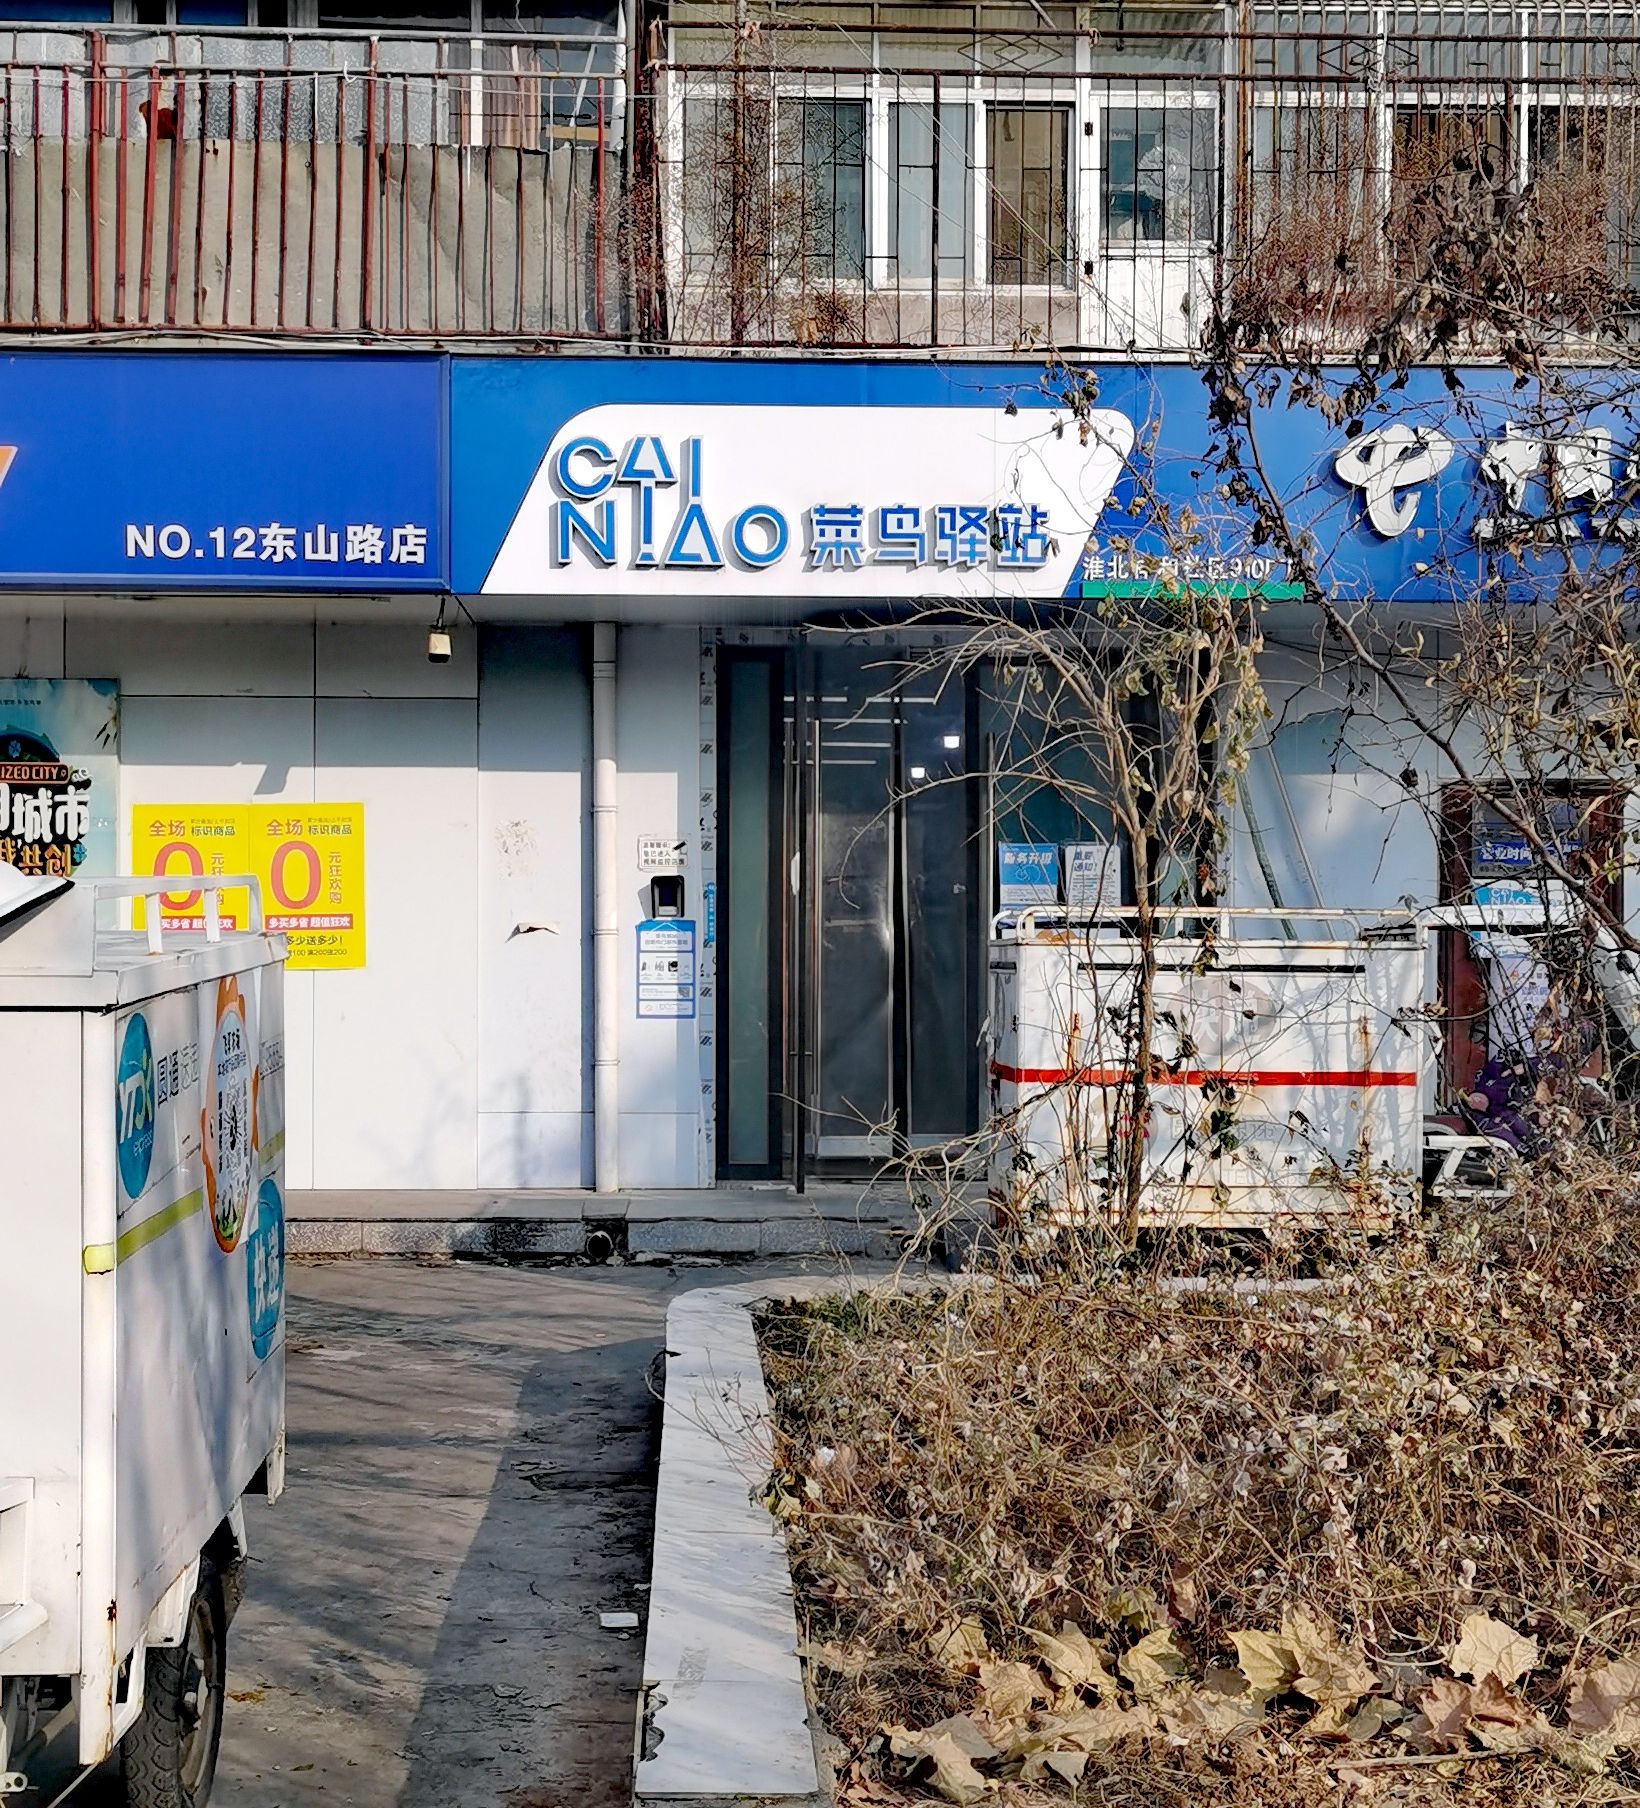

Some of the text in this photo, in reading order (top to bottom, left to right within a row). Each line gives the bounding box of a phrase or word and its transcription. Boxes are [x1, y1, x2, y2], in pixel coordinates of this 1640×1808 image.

[555, 433, 703, 499] CAI
[124, 522, 429, 566] NO.12东山路店
[809, 501, 1053, 569] 菜鸟驿站
[31, 765, 59, 780] CITY
[149, 819, 186, 838] 全场
[191, 825, 236, 837] 标识商品
[266, 819, 353, 837] 全场 标识商品
[153, 841, 204, 911] 0
[270, 840, 322, 910] 0
[328, 851, 343, 905] 元狂欢购
[191, 917, 234, 930] 超欢
[268, 915, 351, 930] 多买多省 超值狂欢
